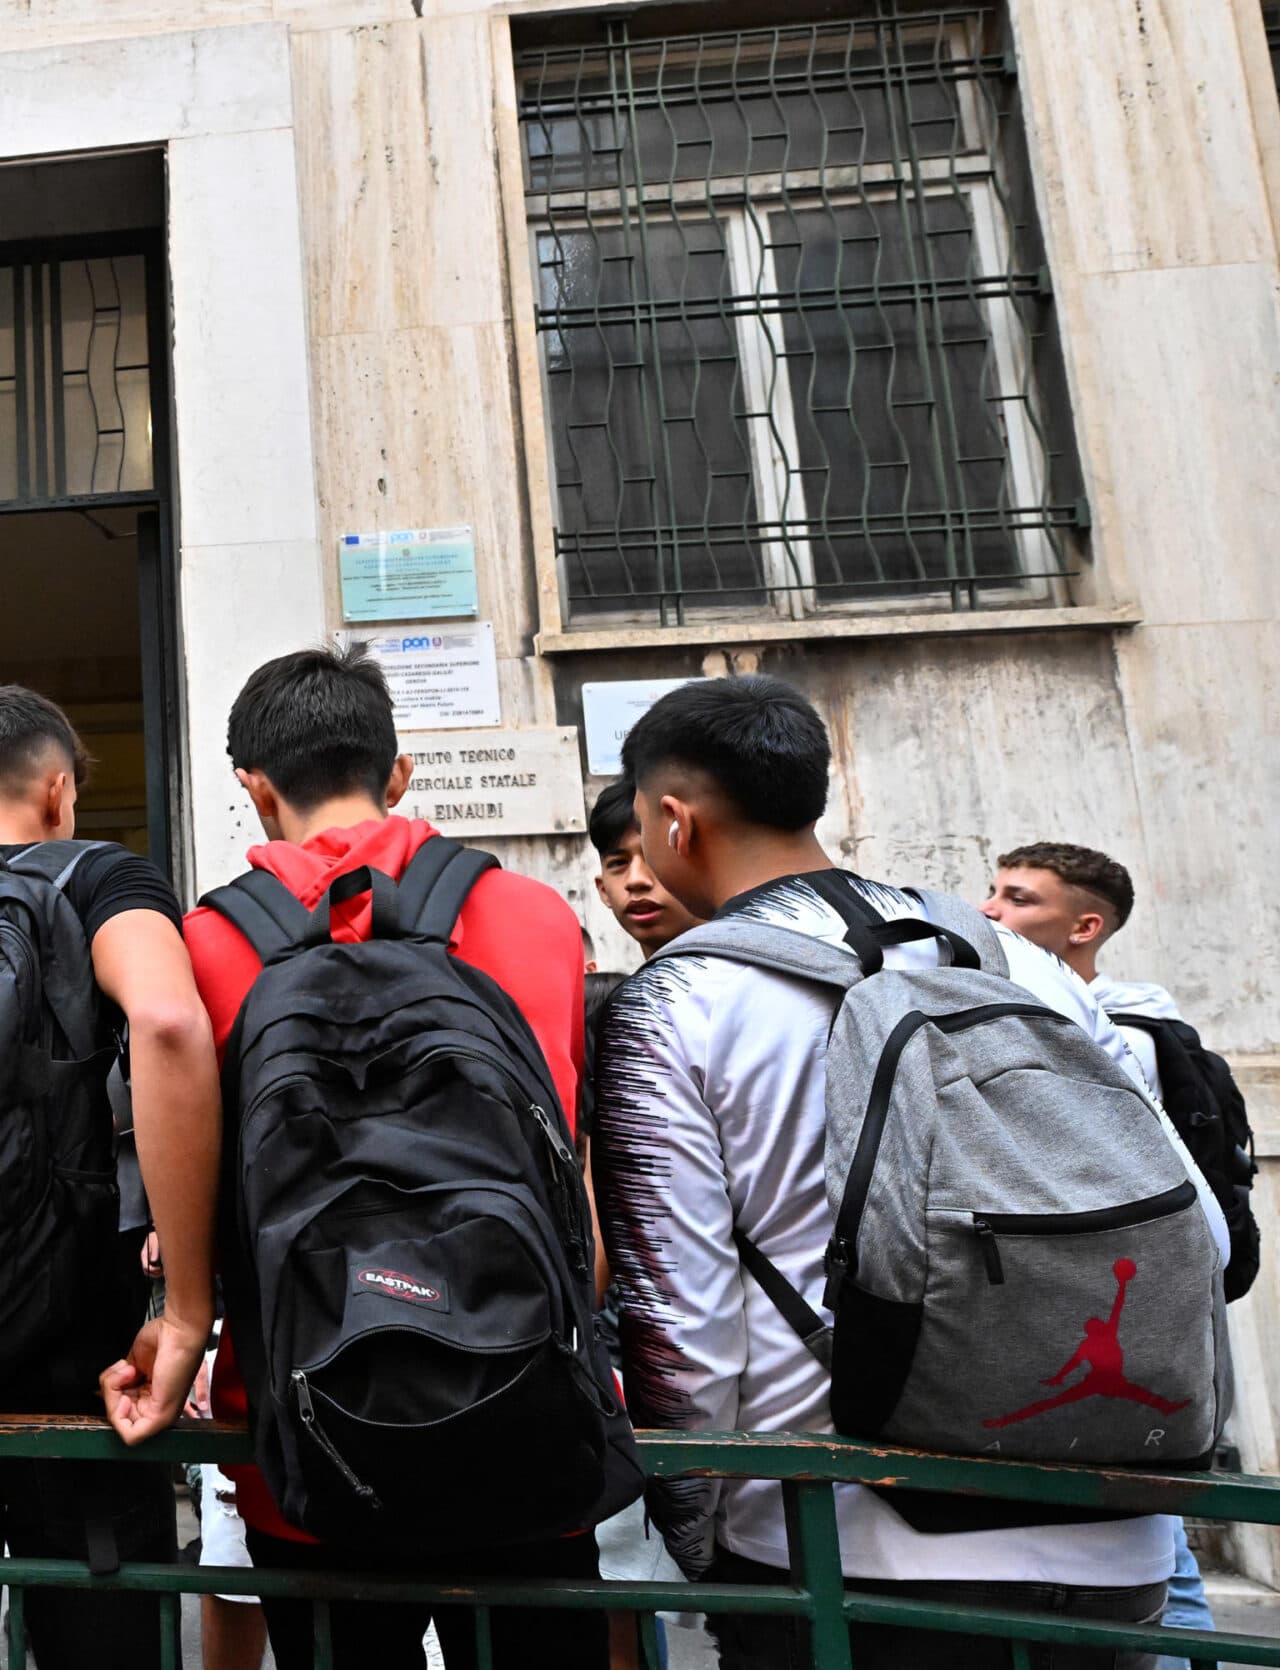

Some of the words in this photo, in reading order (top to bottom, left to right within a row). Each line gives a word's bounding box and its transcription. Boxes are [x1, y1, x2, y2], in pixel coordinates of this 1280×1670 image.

[402, 636, 430, 652] pon
[409, 751, 452, 765] ITUTO
[459, 748, 516, 764] TECNICO
[407, 776, 473, 791] MERCIALE
[480, 773, 537, 788] STATALE
[365, 1272, 434, 1298] EASTPAK
[984, 1429, 1166, 1451] AIR
